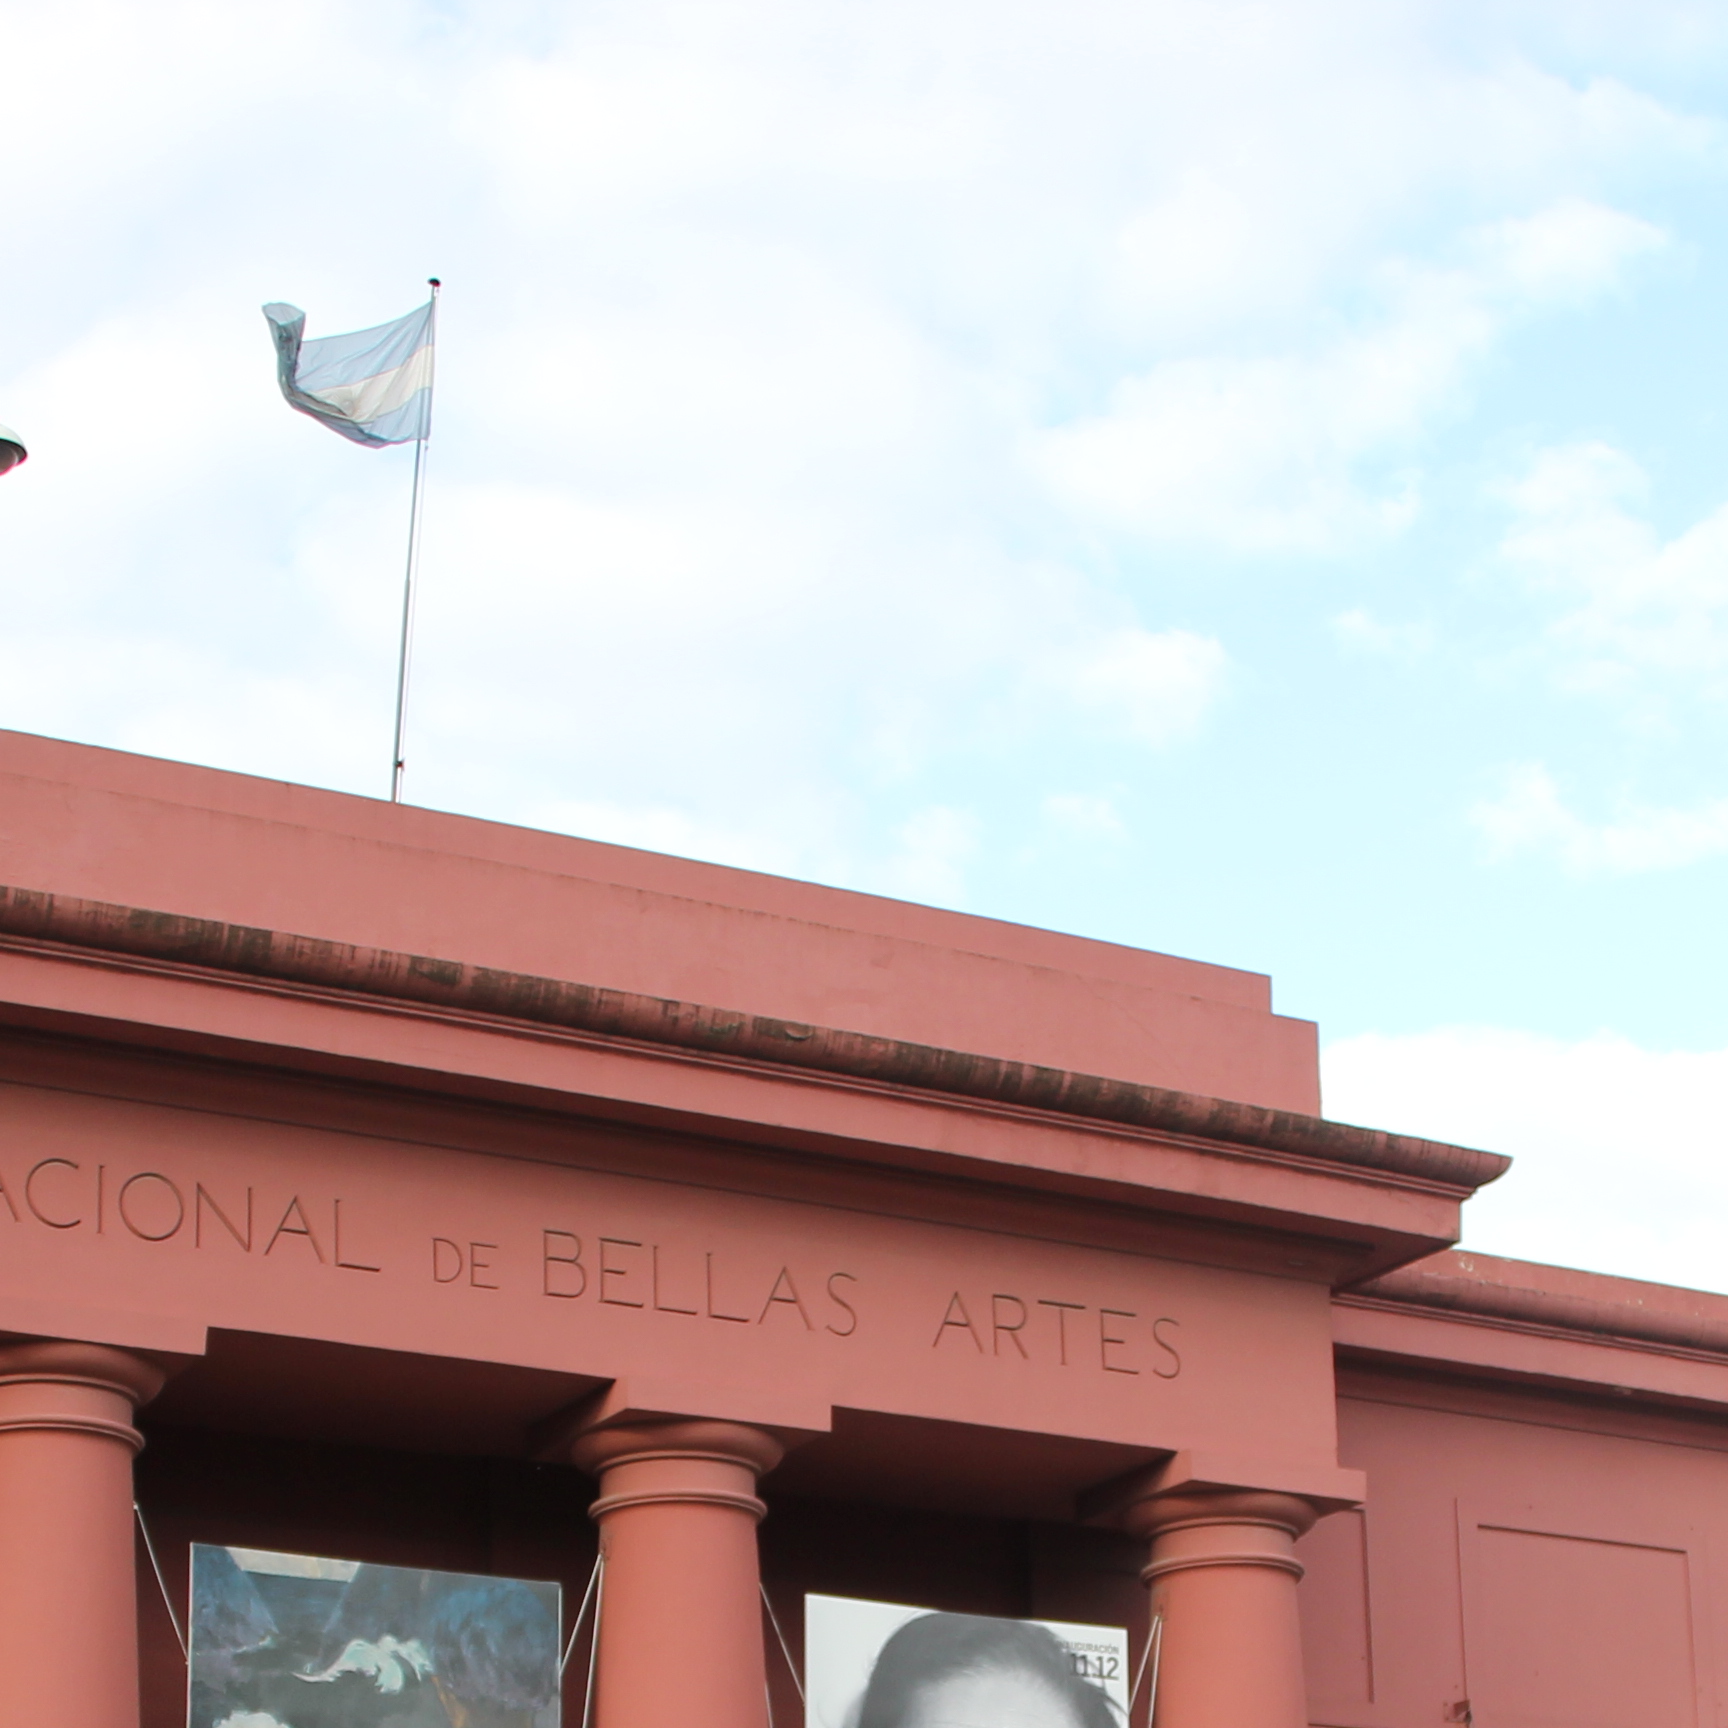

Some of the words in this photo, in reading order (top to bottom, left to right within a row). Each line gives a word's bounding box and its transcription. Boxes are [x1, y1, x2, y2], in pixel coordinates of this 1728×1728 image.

[432, 1237, 500, 1290] DE
[542, 1228, 858, 1337] BELLAS
[933, 1291, 1182, 1380] ARTES
